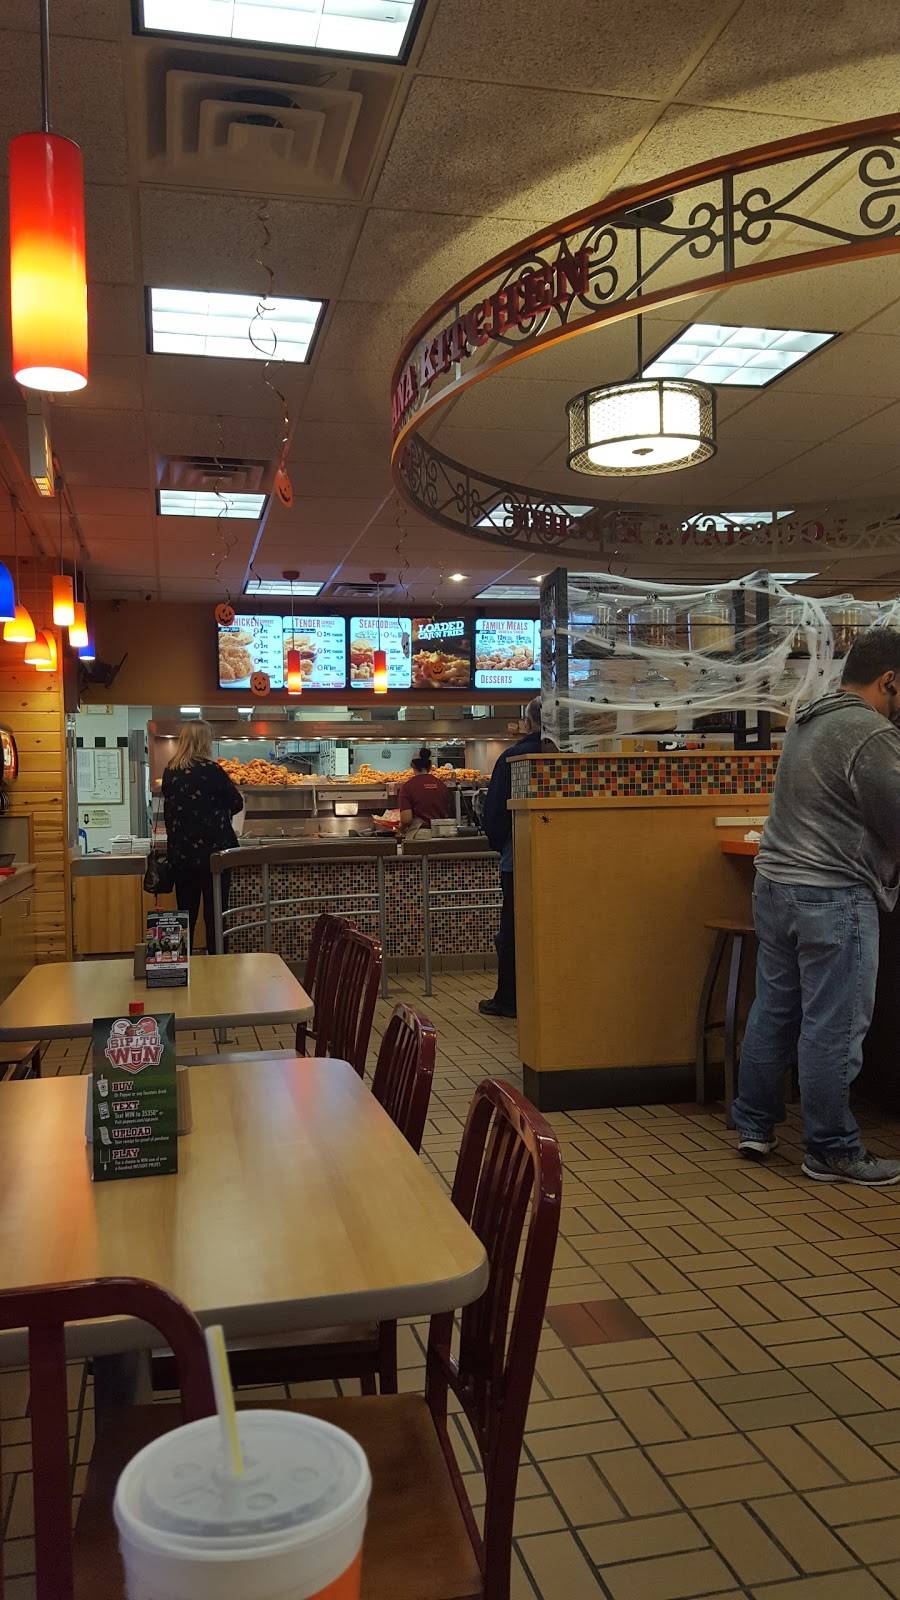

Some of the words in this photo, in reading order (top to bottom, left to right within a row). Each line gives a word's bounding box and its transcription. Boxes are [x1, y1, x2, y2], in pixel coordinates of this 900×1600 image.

[420, 246, 593, 388] KITCHEN
[233, 617, 259, 627] HICKEN
[295, 618, 321, 628] TENDER
[359, 619, 389, 628] SEAFOOD
[418, 621, 464, 633] LOADED
[482, 620, 504, 630] FAMILY
[506, 621, 528, 630] MEALS
[417, 630, 442, 640] CAJUN
[442, 629, 465, 638] FRIES
[480, 674, 512, 684] DESSERTS
[110, 1037, 133, 1048] SIP
[140, 1036, 158, 1046] TO
[112, 1081, 133, 1092] BUY
[112, 1100, 139, 1111] TEXT
[112, 1126, 151, 1138] UPLOAD
[112, 1148, 139, 1159] PLAY
